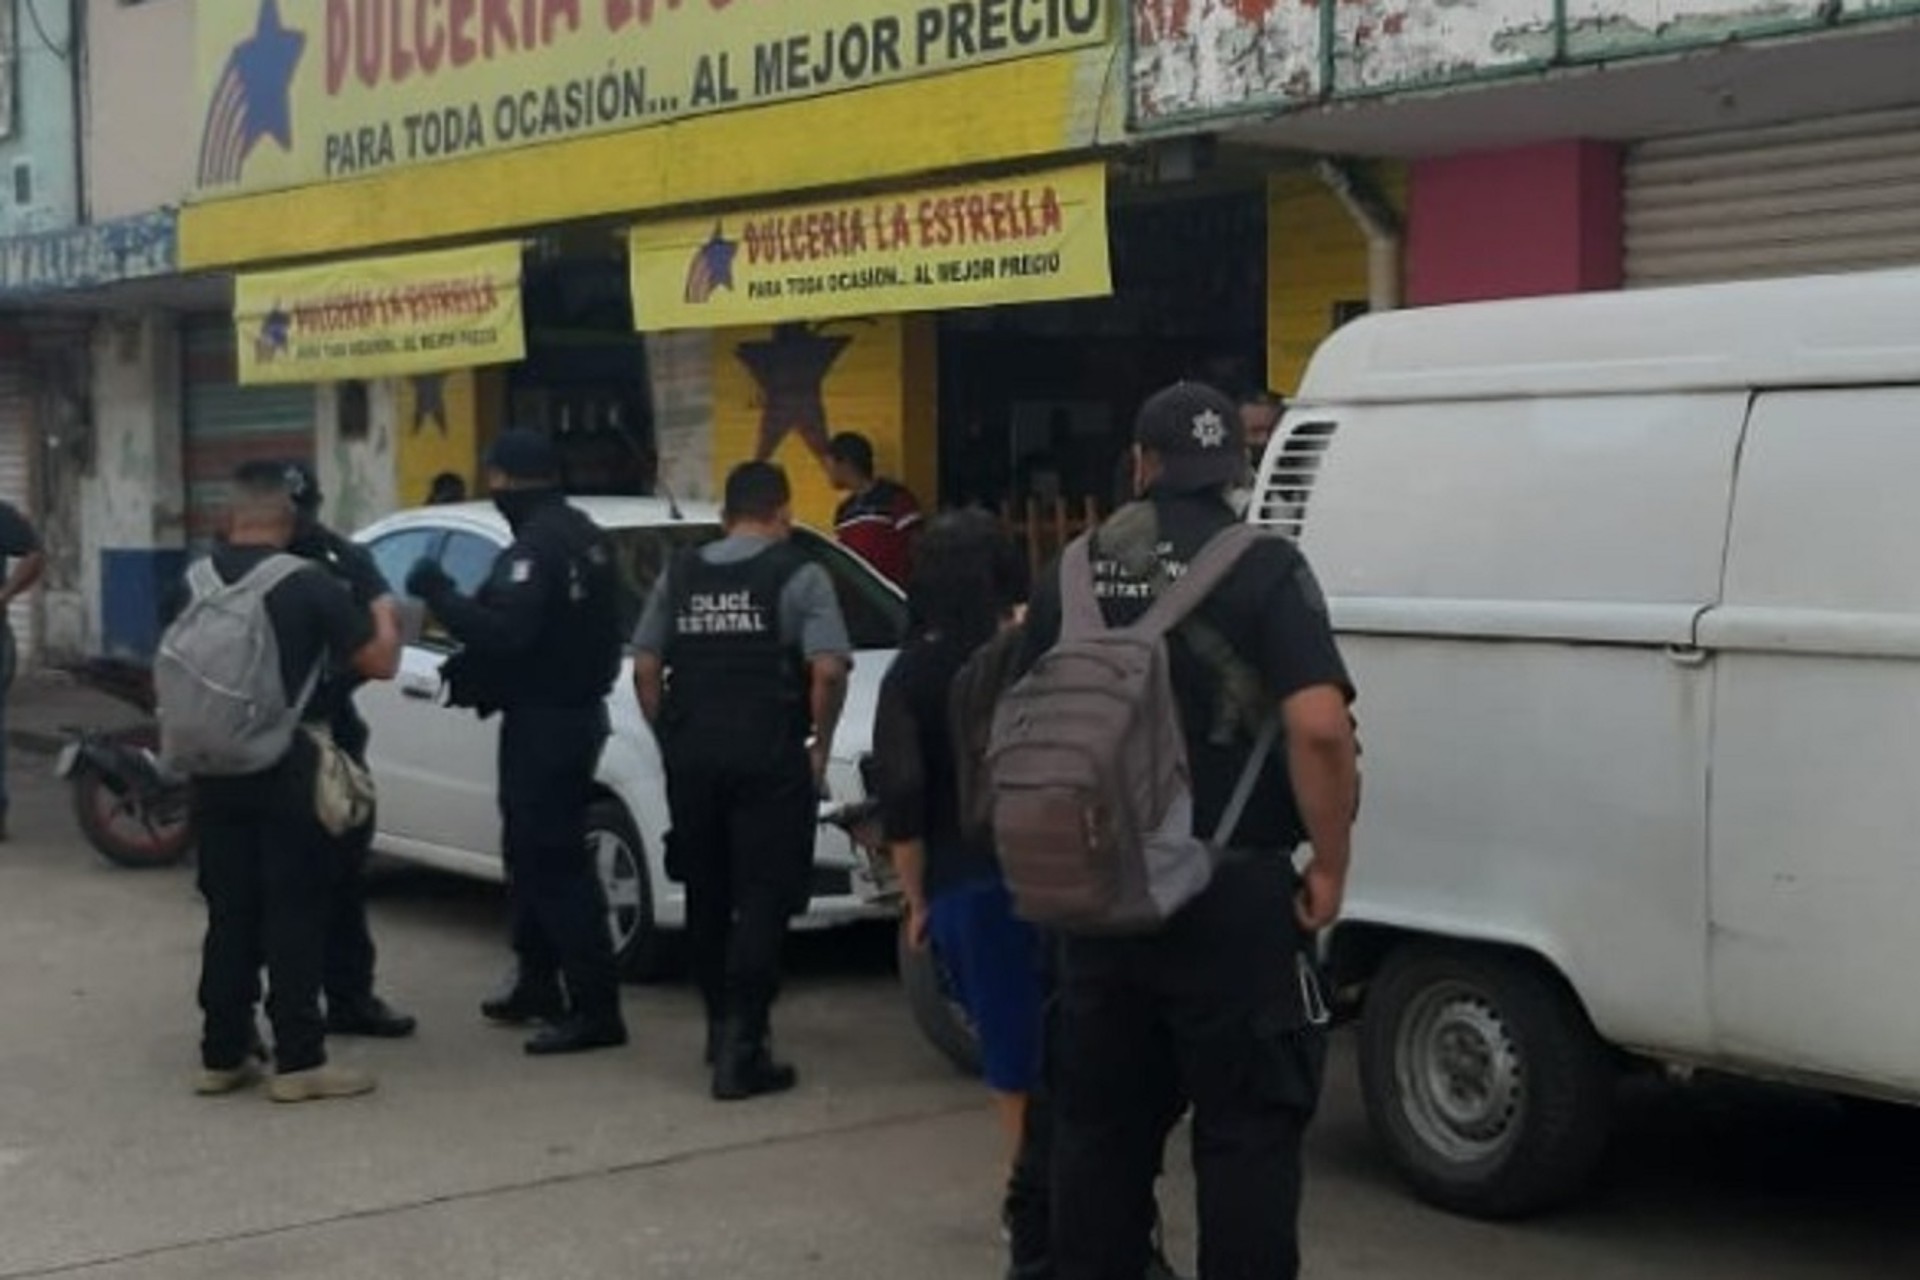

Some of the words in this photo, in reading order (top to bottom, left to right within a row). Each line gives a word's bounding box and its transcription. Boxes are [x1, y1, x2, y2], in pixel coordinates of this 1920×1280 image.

[326, 134, 394, 175] PARA
[403, 114, 485, 162] TODA
[692, 52, 739, 107] AL
[754, 18, 902, 97] MEJOR
[916, 0, 1098, 66] PRECIO
[874, 202, 909, 251] LA
[919, 186, 1062, 247] ESTRELLA
[748, 280, 782, 298] PARA
[787, 276, 824, 295] TODA
[915, 262, 934, 284] AL
[938, 257, 995, 282] MEJOR
[1000, 250, 1060, 278] PRECIO
